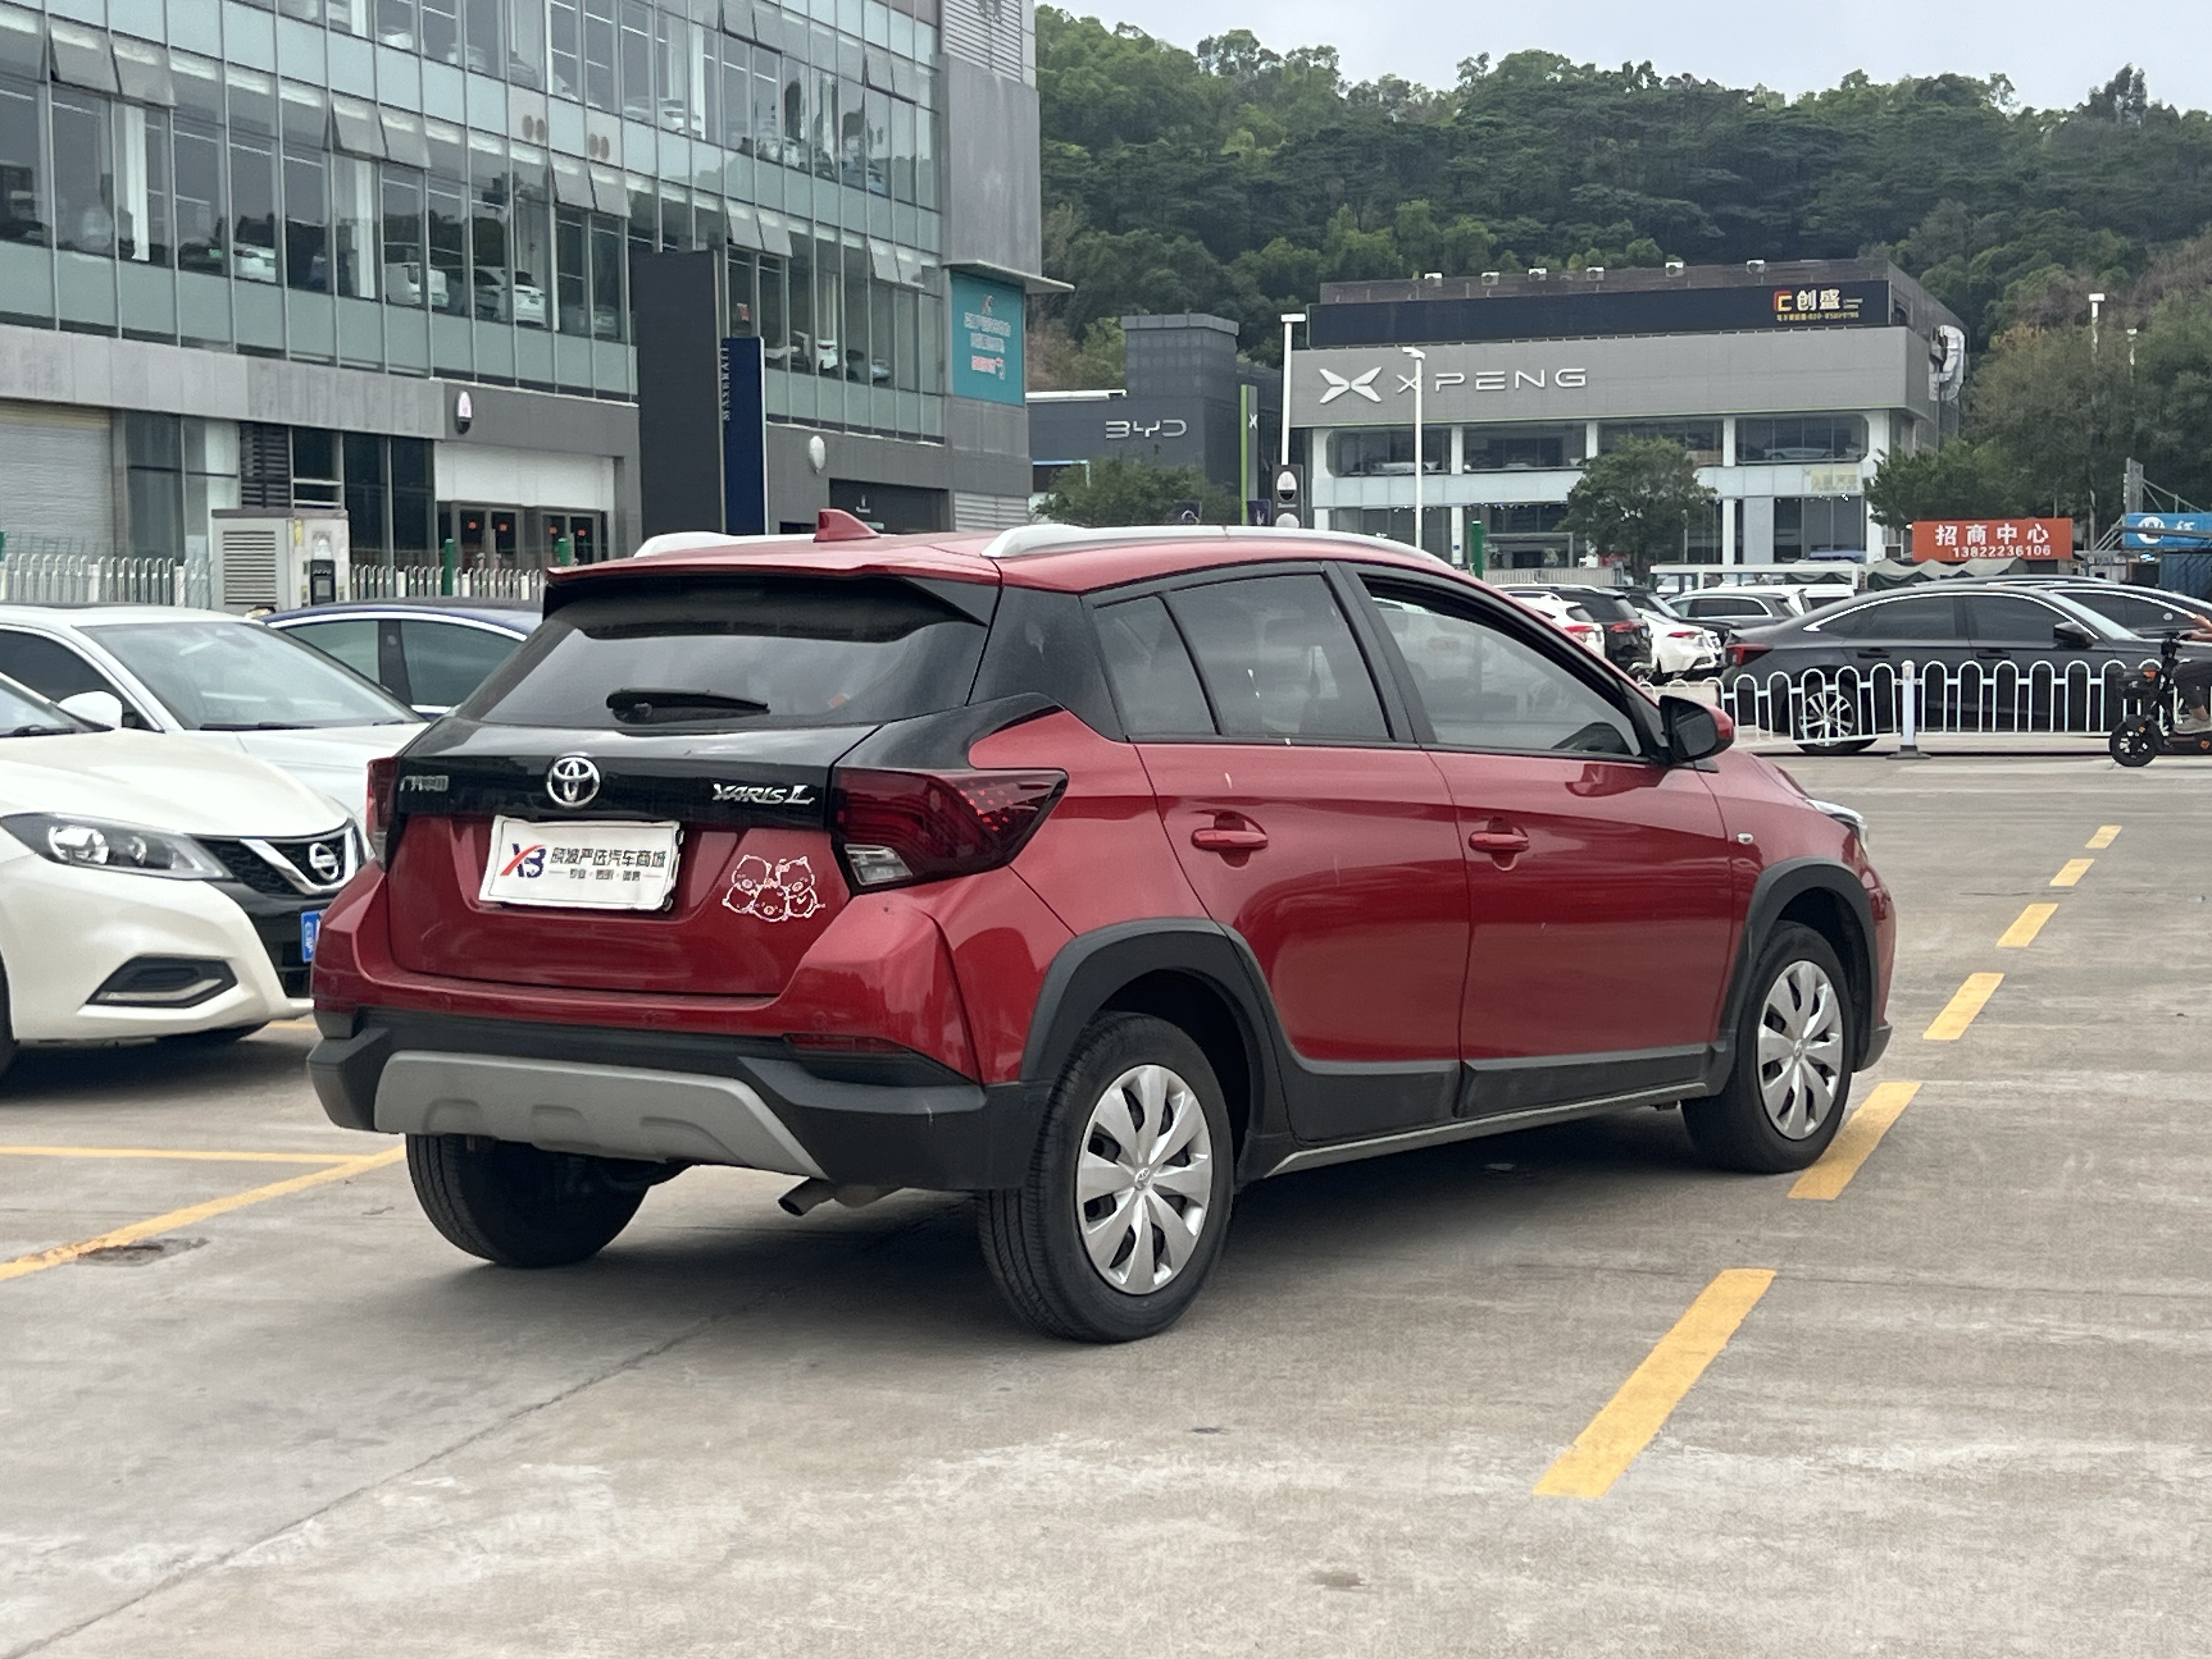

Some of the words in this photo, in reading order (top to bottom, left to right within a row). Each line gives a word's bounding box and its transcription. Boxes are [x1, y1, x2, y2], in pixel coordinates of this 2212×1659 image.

[1796, 289, 1841, 311] 创盛
[1396, 368, 1587, 394] XPENG
[1105, 419, 1188, 439] BYD
[1934, 523, 2050, 546] 招商中心
[712, 783, 787, 805] YARIS
